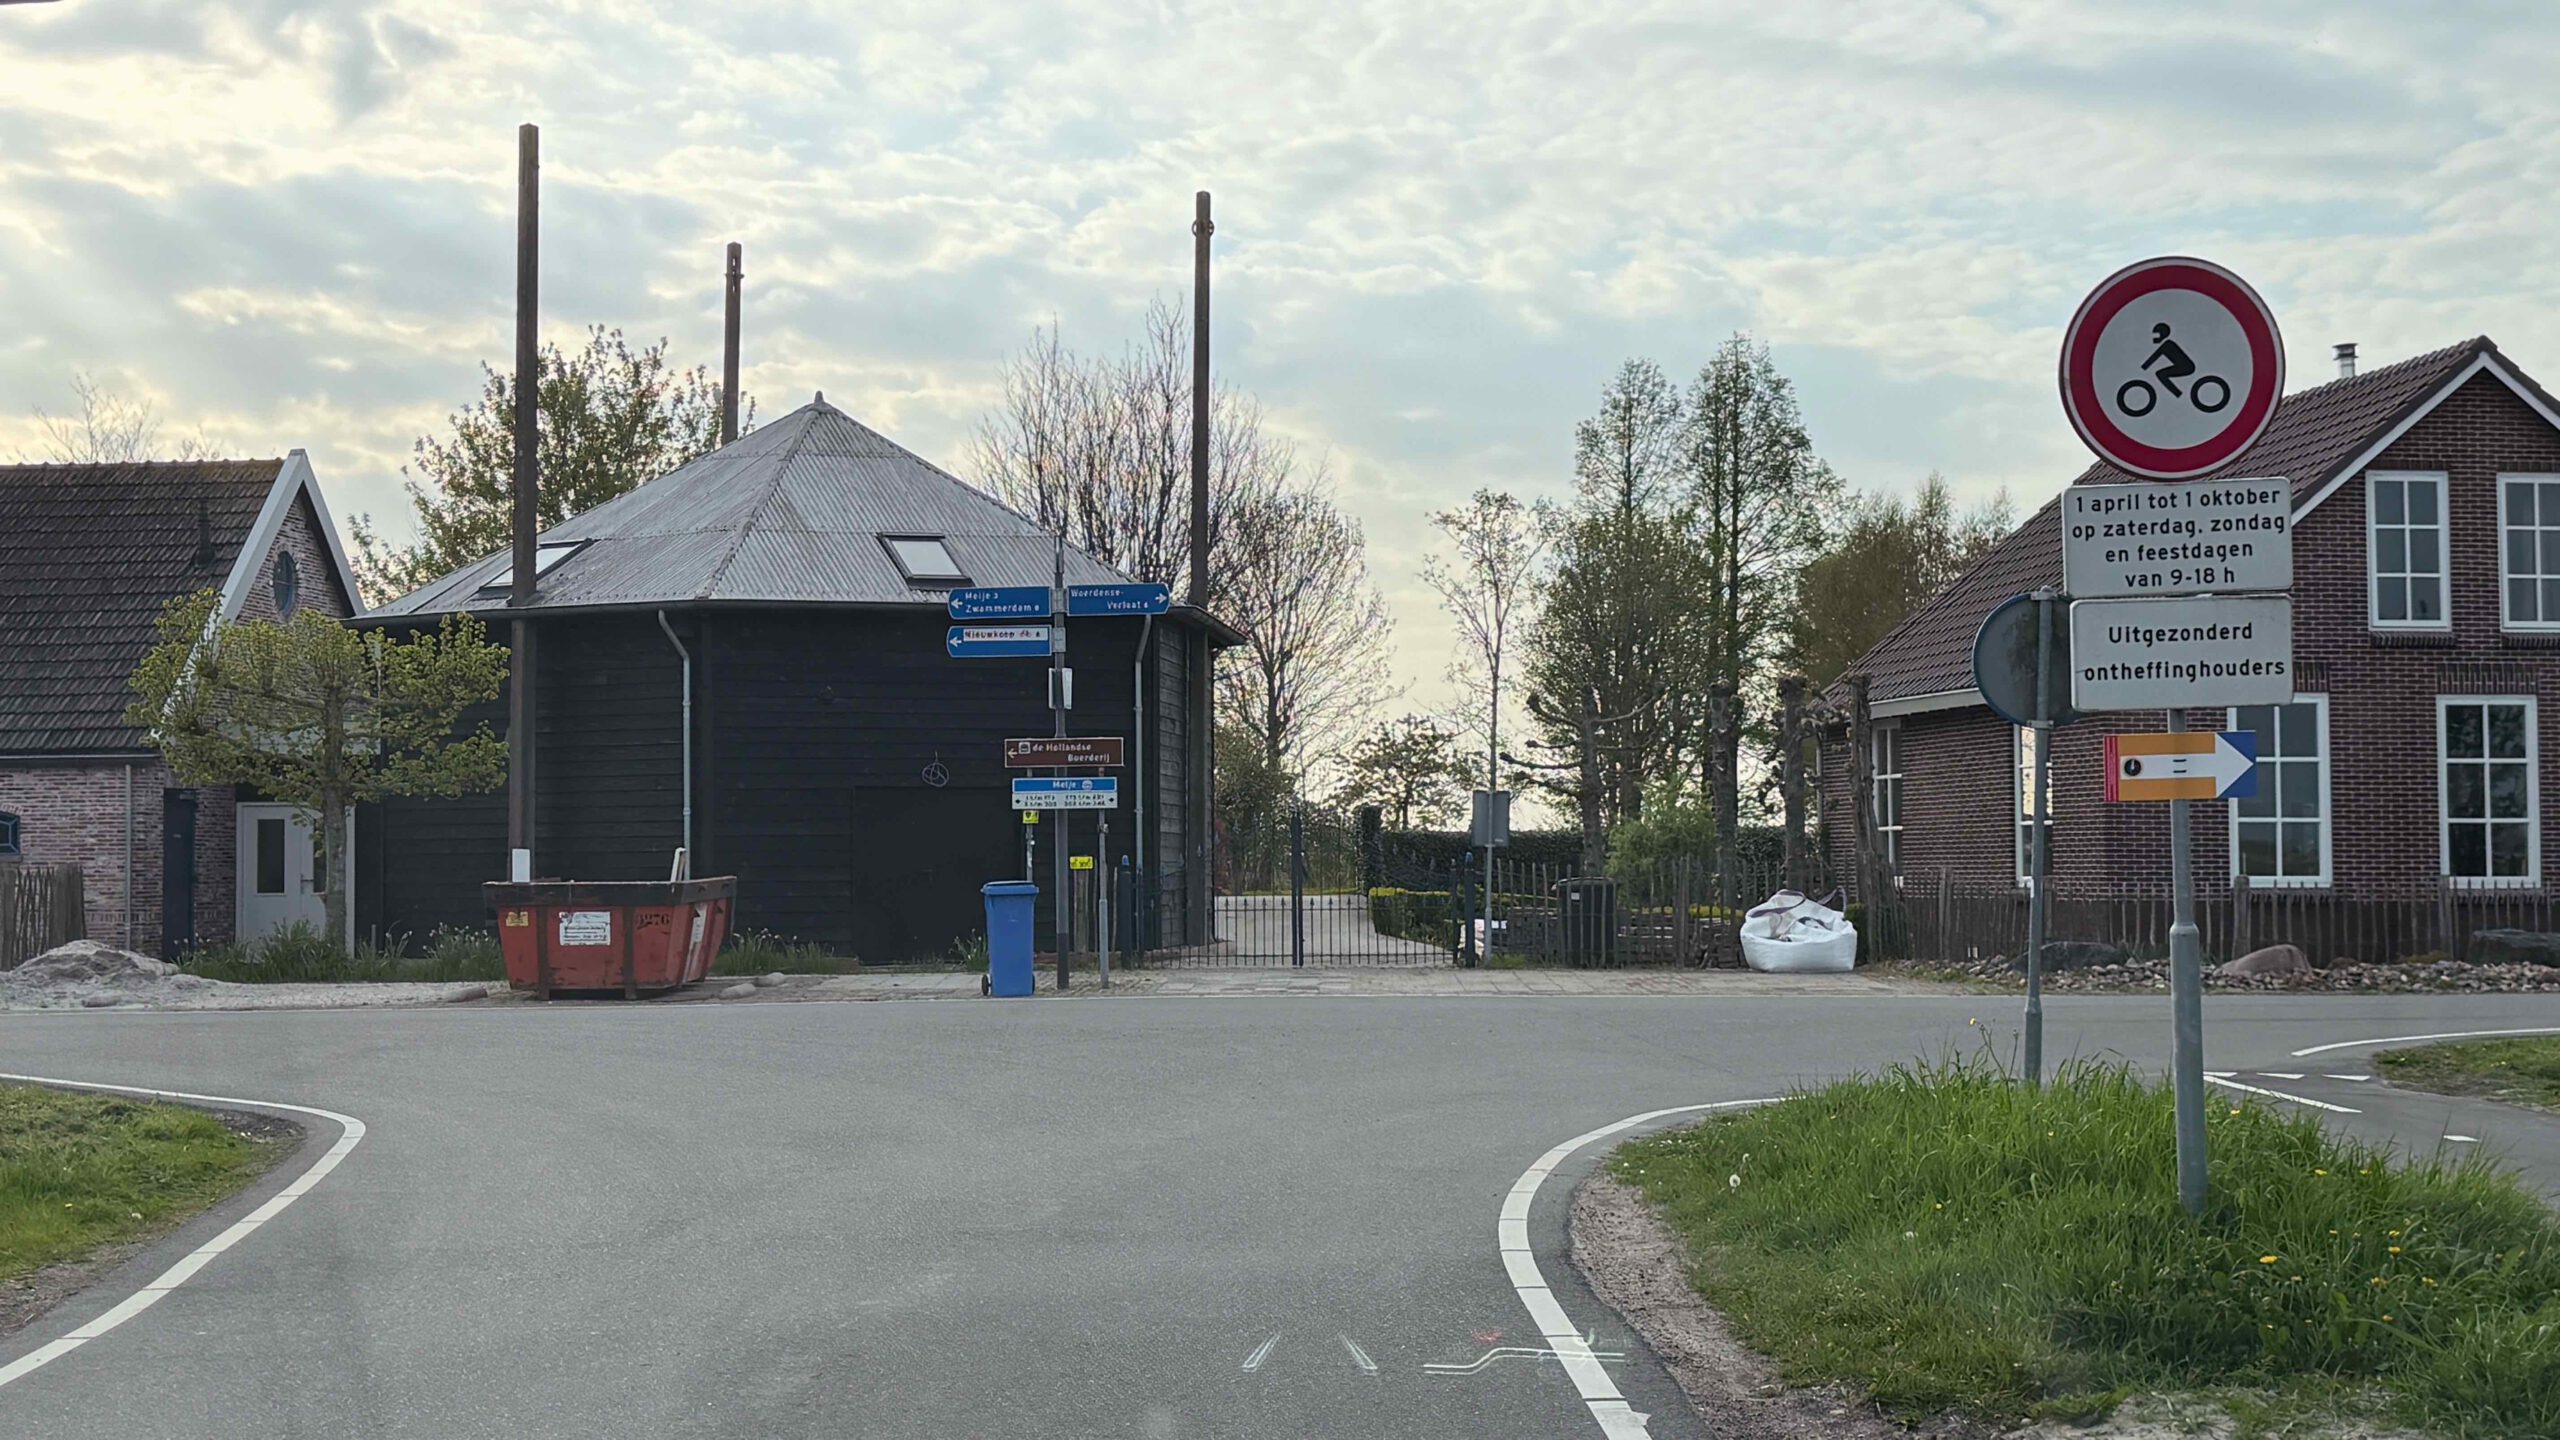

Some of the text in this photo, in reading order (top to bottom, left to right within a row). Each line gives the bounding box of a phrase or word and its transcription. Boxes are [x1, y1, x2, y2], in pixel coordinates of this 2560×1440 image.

[2077, 489, 2280, 514] 1 april tot 1 oktober
[2072, 525, 2095, 541] op
[2211, 514, 2284, 533] zondag
[2106, 543, 2253, 562] en feestdagen
[2125, 568, 2235, 587] van 9-18 h
[965, 592, 991, 602] Meije
[966, 604, 1031, 613] Zwammerdam
[2108, 622, 2252, 647] Uitgezonderd
[2085, 659, 2285, 682] ontheffinghouders
[1068, 754, 1110, 763] Boerderij
